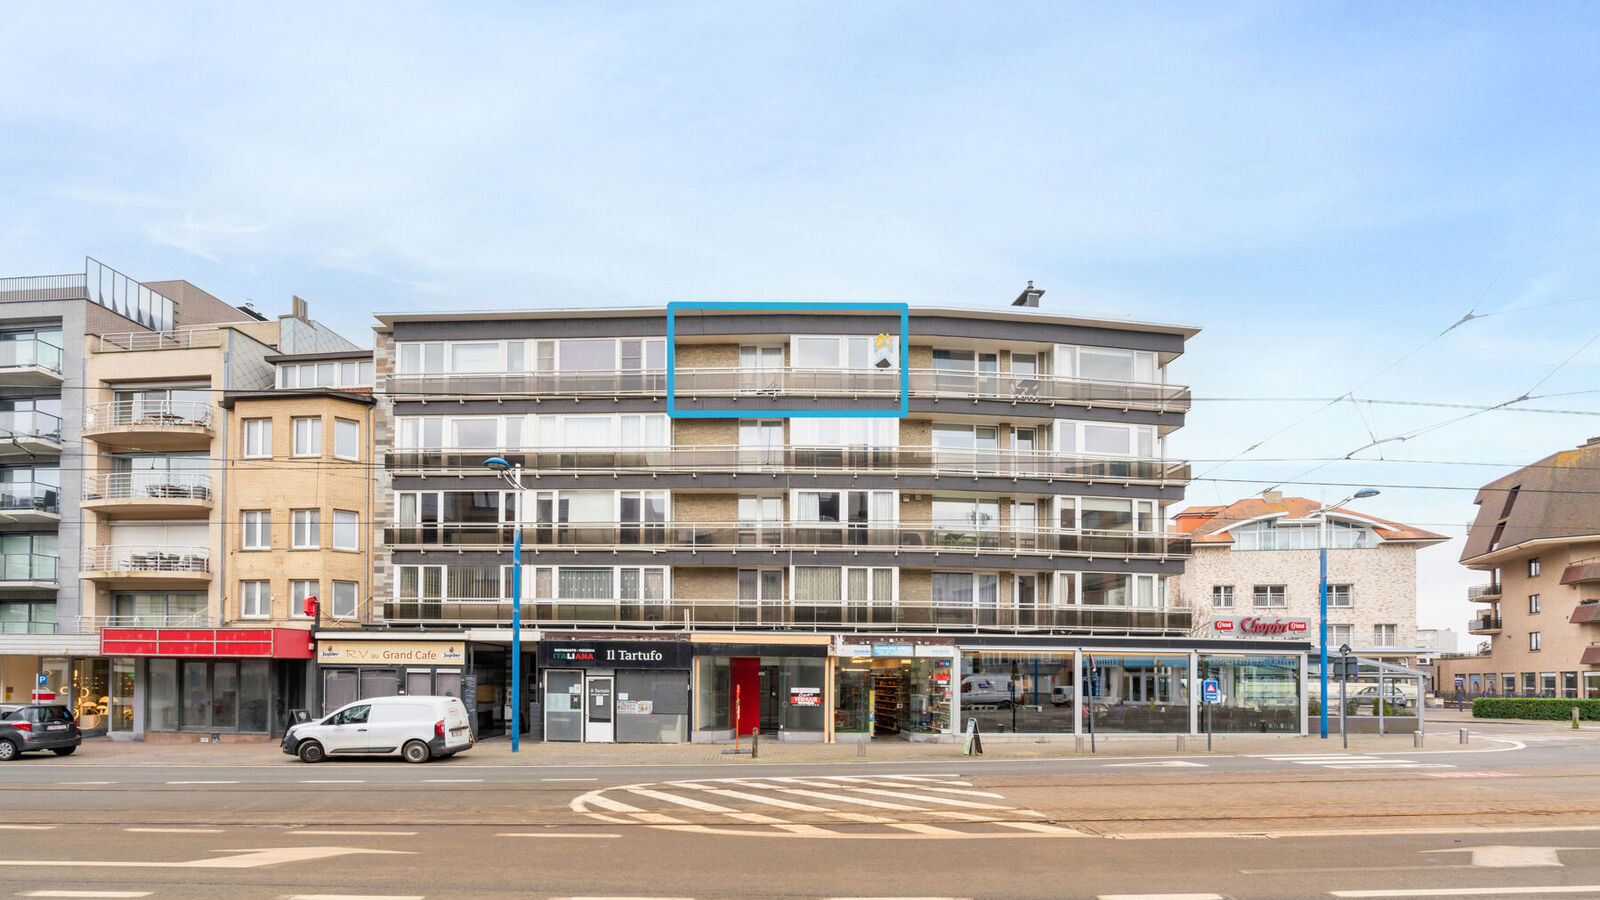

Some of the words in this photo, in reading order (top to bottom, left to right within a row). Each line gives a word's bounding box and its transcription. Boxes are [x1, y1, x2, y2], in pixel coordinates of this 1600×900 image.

[1240, 617, 1289, 635] Chopin
[382, 650, 413, 660] Grand
[415, 650, 437, 660] Cafe
[606, 649, 615, 661] Il
[617, 649, 663, 661] Tartufo
